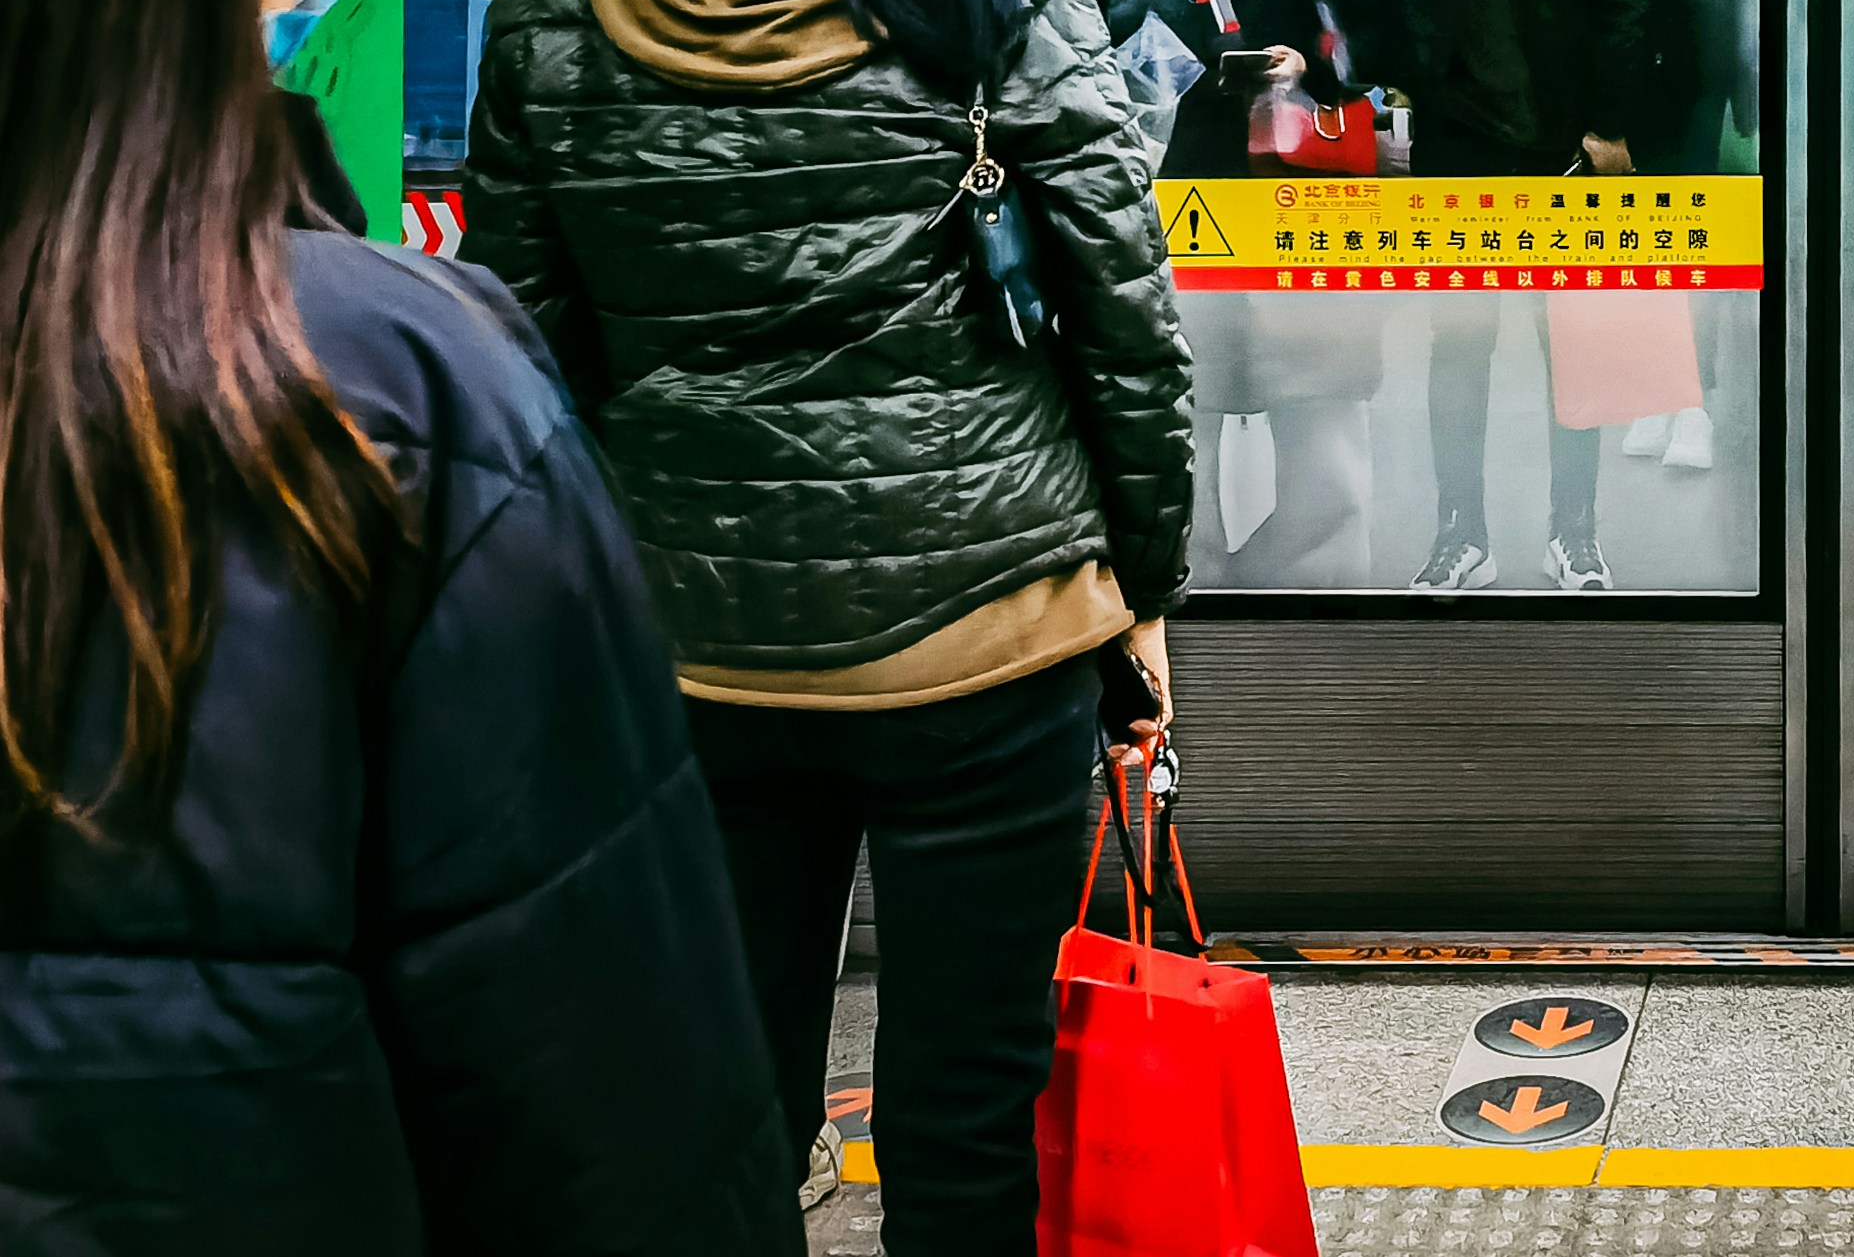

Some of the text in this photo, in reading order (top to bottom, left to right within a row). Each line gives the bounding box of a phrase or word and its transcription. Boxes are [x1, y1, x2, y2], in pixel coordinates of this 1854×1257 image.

[1304, 184, 1381, 199] 北京银行
[1648, 214, 1702, 222] BEIJING
[1275, 229, 1709, 251] 请注意列车与站台之间的空隙
[1278, 254, 1707, 264] Please mind the gap between the train and platform
[1275, 269, 1708, 289] 请在黄色安全线以外排队候车
